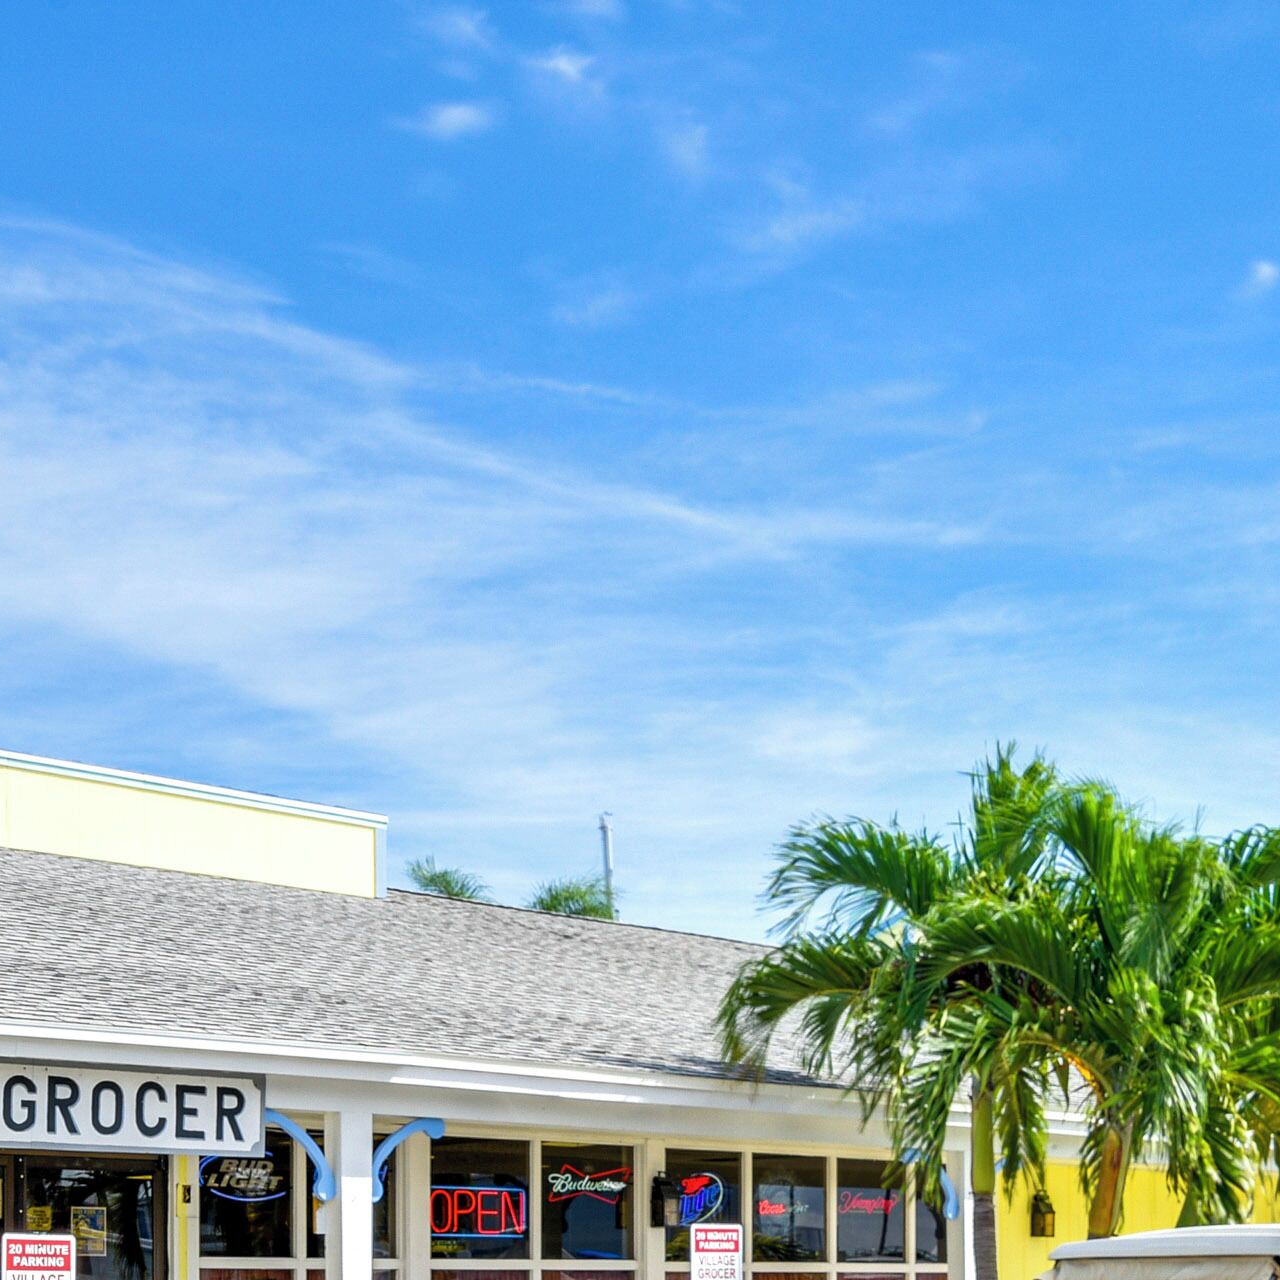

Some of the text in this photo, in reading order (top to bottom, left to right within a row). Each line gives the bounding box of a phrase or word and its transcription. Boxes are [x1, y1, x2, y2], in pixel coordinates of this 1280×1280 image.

[2, 1074, 246, 1142] GROCER
[220, 1159, 274, 1173] BUD
[207, 1173, 283, 1191] LIGHT
[431, 1189, 524, 1234] OPEN
[8, 1244, 23, 1255] 20
[25, 1244, 69, 1255] MINUTE
[13, 1256, 65, 1267] PARKING
[699, 1255, 735, 1265] VILLAGE
[698, 1268, 736, 1279] GROCER
